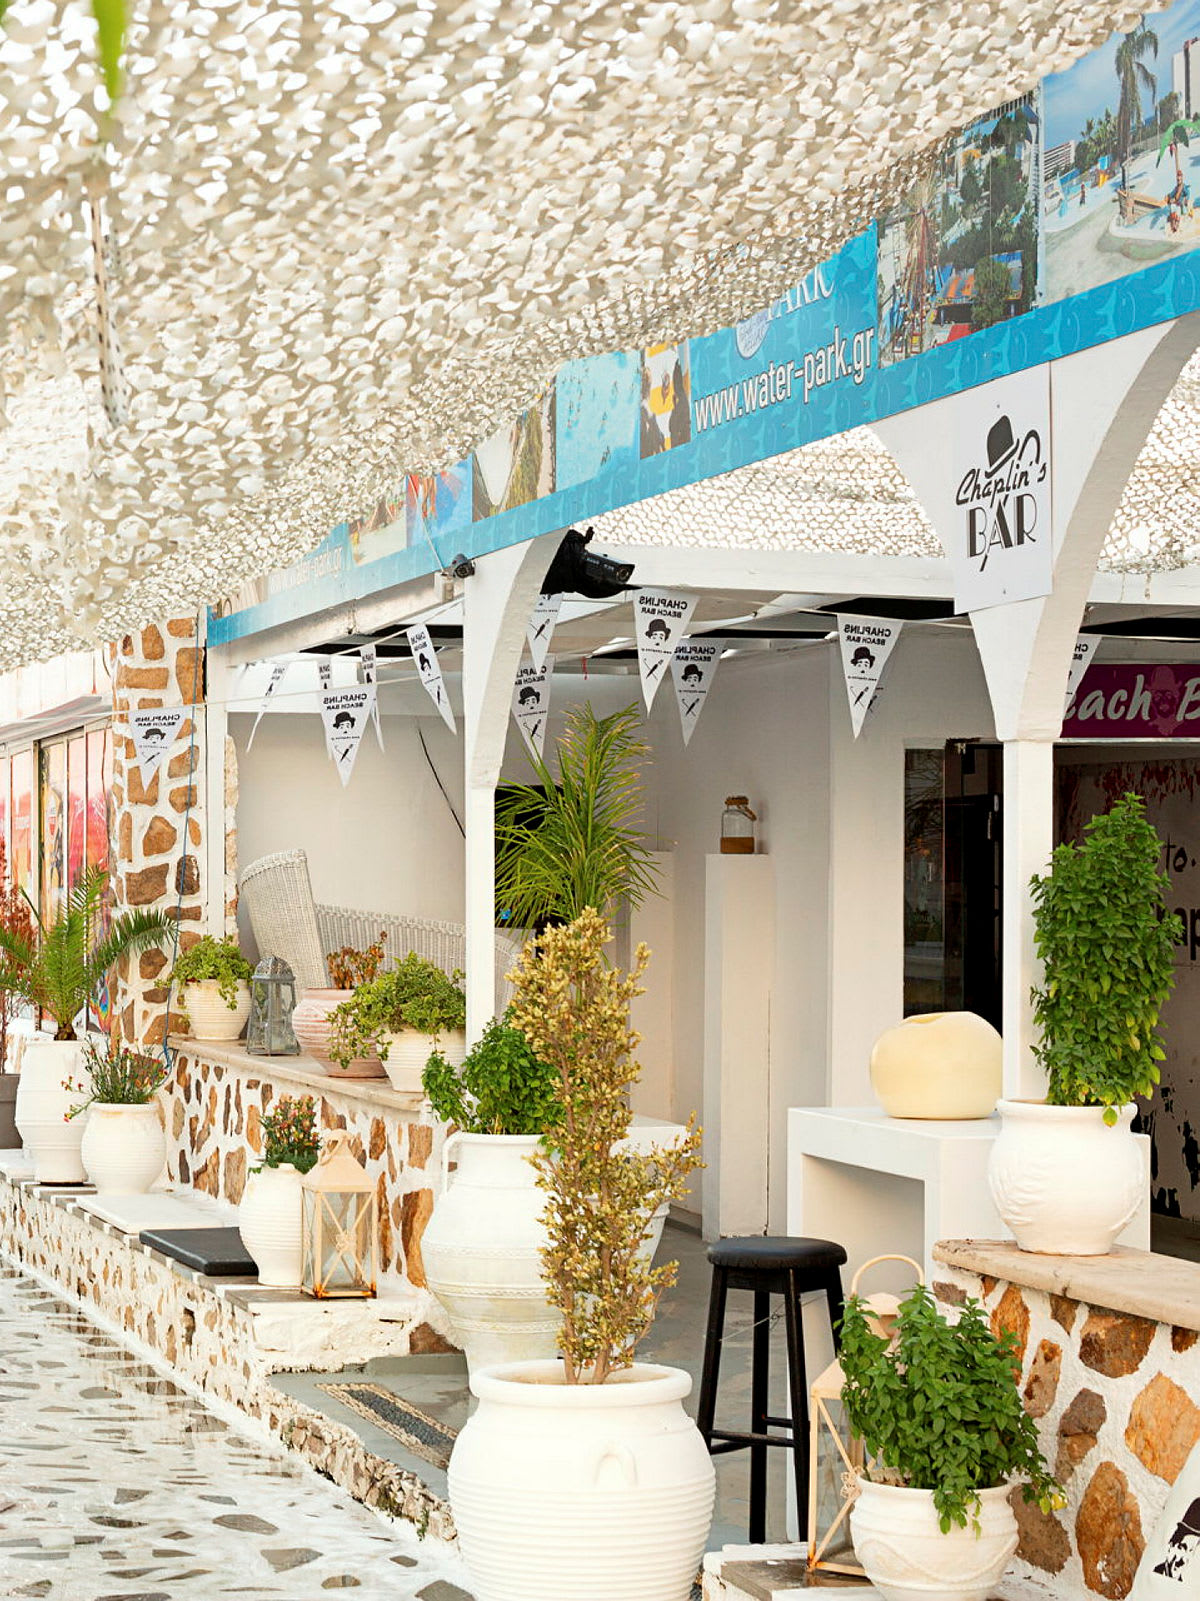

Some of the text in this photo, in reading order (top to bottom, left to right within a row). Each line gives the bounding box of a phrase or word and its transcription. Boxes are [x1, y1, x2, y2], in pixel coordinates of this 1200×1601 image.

[694, 323, 875, 434] www.water-park.gr
[956, 458, 1047, 509] Chaplin's
[966, 493, 1038, 558] BAR
